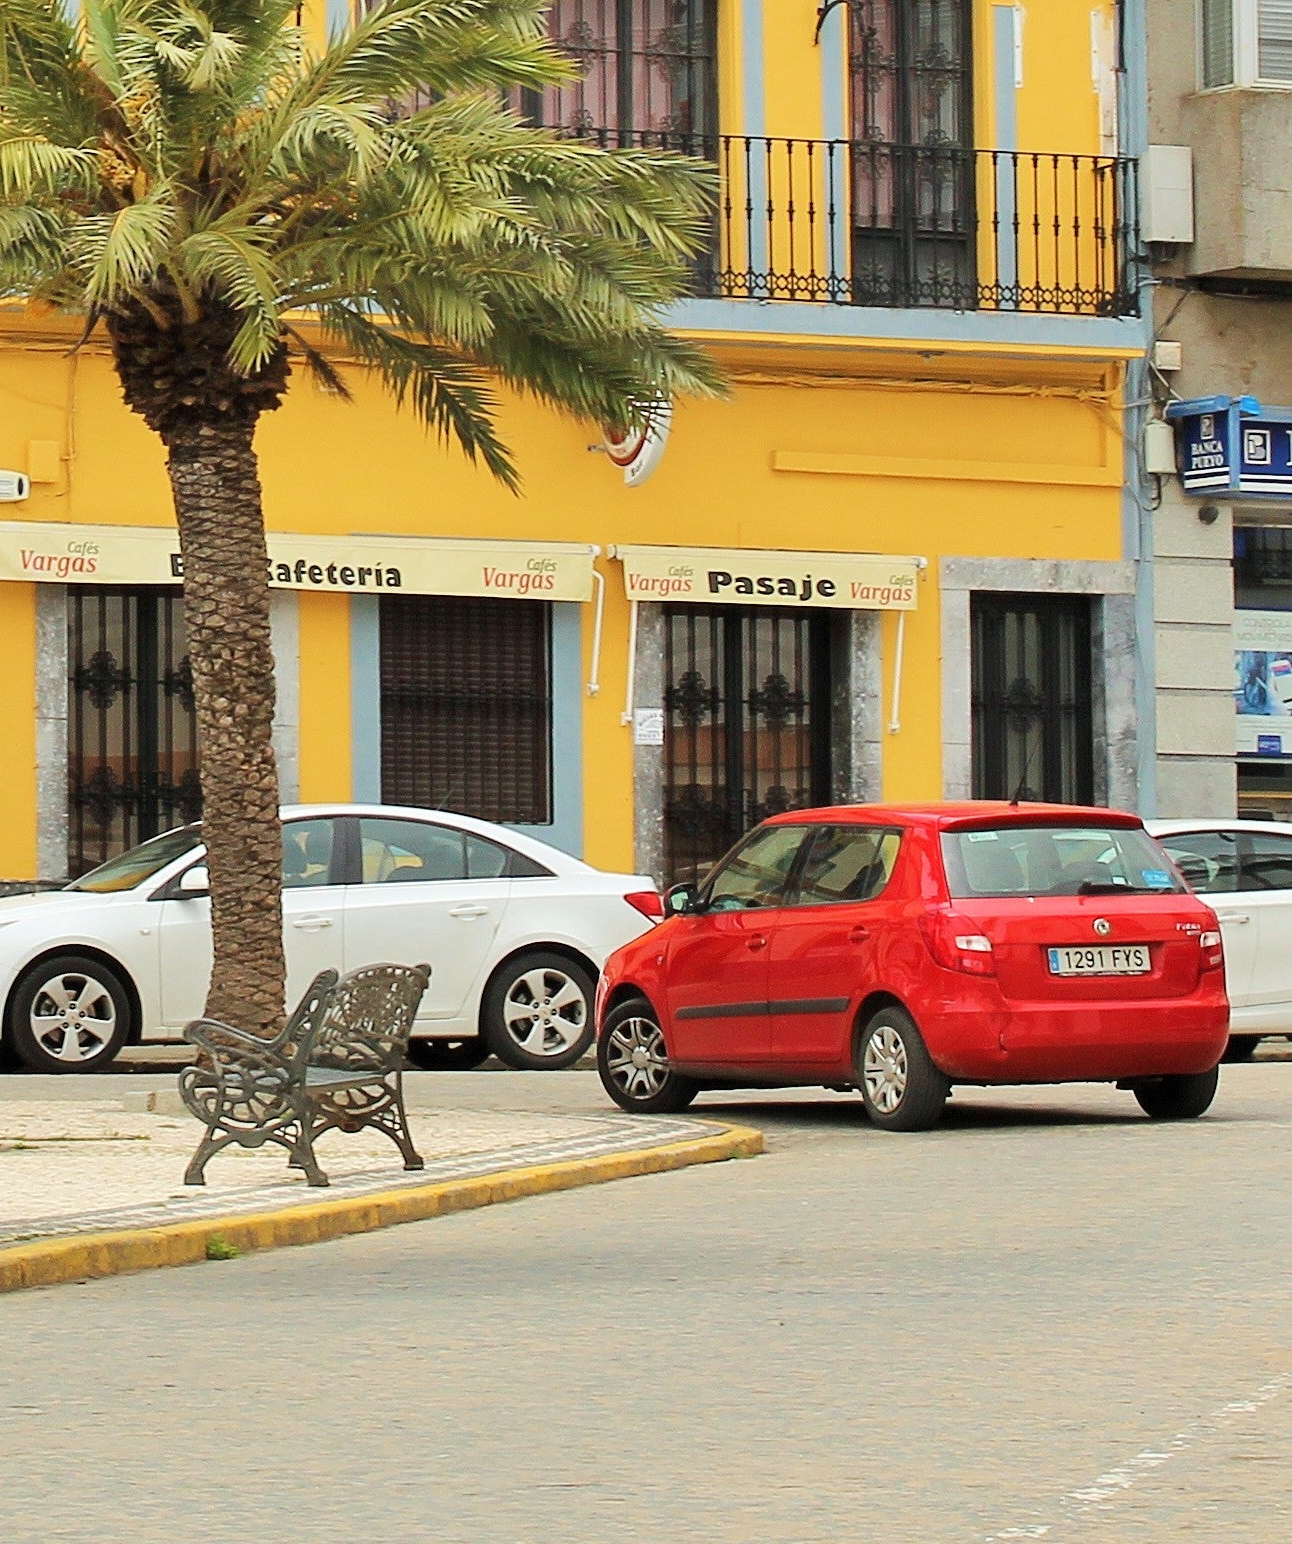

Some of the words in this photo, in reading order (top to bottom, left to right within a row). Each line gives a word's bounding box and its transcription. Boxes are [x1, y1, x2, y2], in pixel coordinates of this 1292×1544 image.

[1191, 441, 1223, 455] BANCA
[67, 541, 100, 555] Cafés
[20, 549, 99, 578] Vargas
[526, 558, 557, 573] Cafés
[668, 565, 694, 578] Cafés
[483, 567, 555, 594] Vargas
[628, 573, 693, 596] Vargas
[708, 571, 836, 601] Pasaje
[888, 574, 915, 587] Cafés
[850, 582, 913, 605] Vargas
[1065, 950, 1105, 969] 1291
[1112, 949, 1144, 968] FYS
